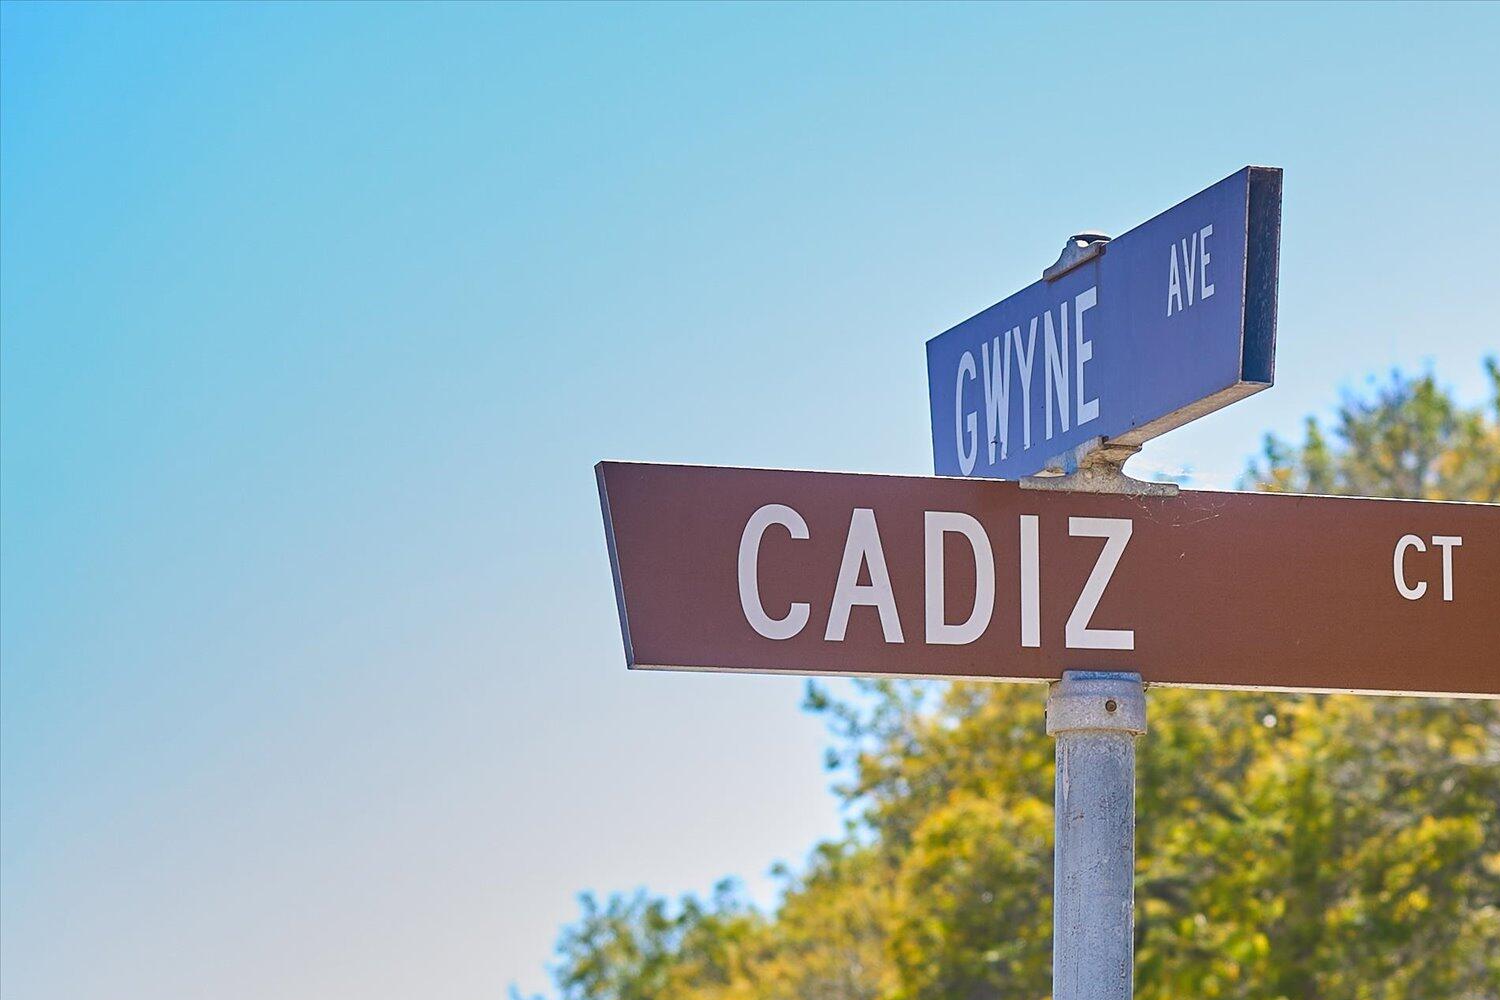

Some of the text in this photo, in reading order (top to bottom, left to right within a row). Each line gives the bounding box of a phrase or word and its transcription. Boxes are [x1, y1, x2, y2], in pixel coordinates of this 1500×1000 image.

[955, 224, 1215, 476] GWYNE AVE
[738, 503, 1463, 651] CADIZ CT
